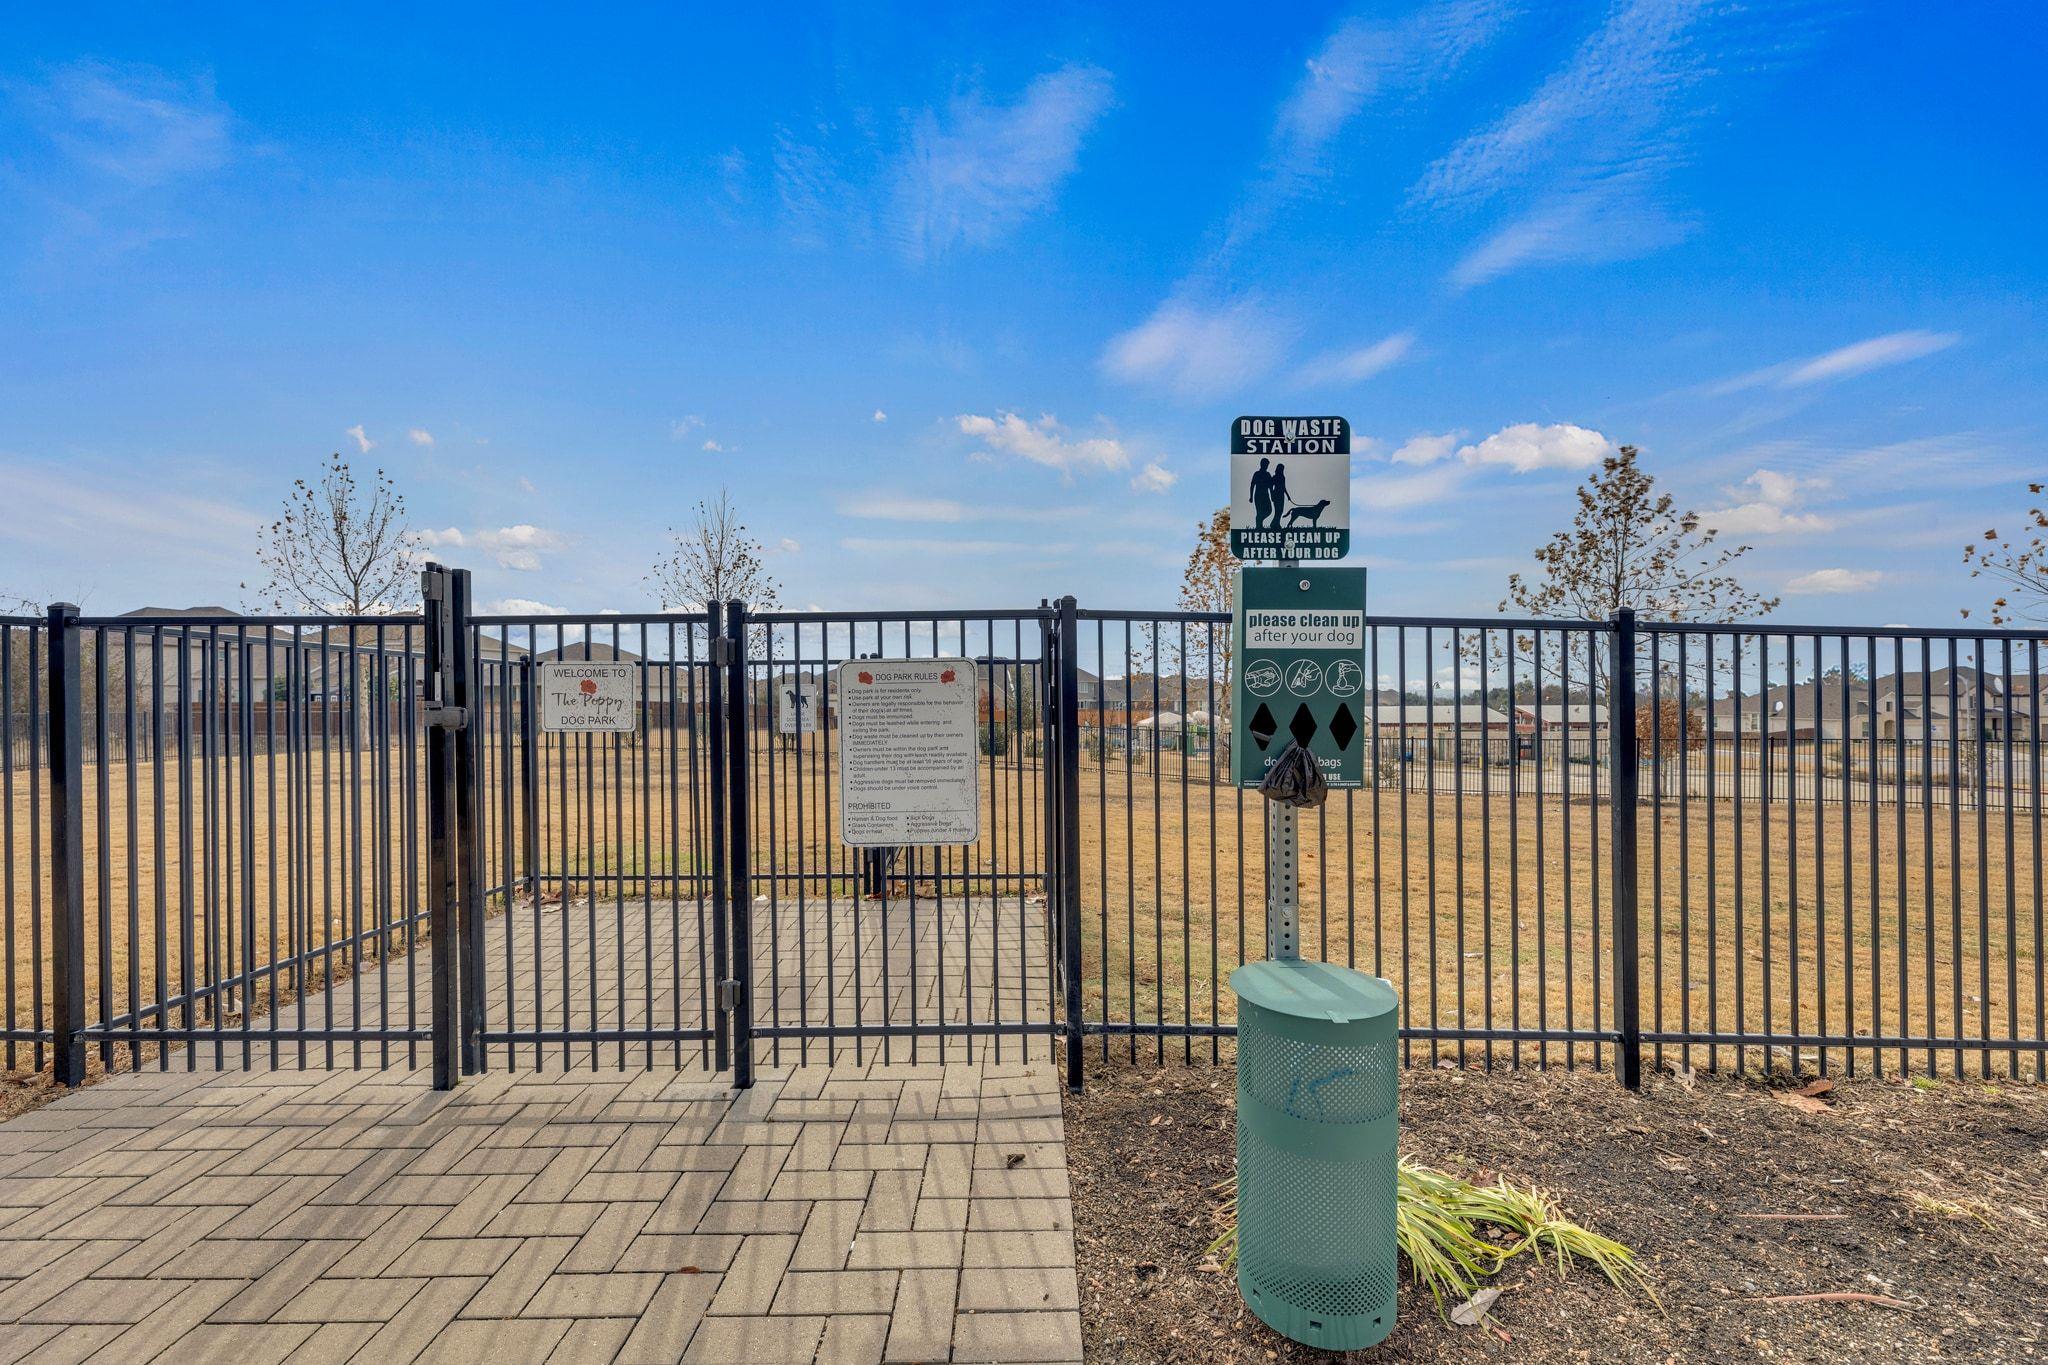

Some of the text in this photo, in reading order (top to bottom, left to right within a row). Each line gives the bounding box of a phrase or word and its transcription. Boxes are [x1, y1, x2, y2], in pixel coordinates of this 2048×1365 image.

[1241, 420, 1341, 436] DOG WASTE
[1247, 440, 1335, 453] STATION
[1241, 532, 1340, 543] PLEASE CLEAN UP
[1242, 547, 1338, 558] AFTER YOUR DOG
[1250, 613, 1359, 628] please clean up
[1254, 629, 1355, 645] after your dog
[553, 669, 626, 678] WELCOME TO
[552, 693, 624, 714] The Poppy
[561, 716, 616, 725] DOG PARK
[1318, 756, 1341, 768] bags
